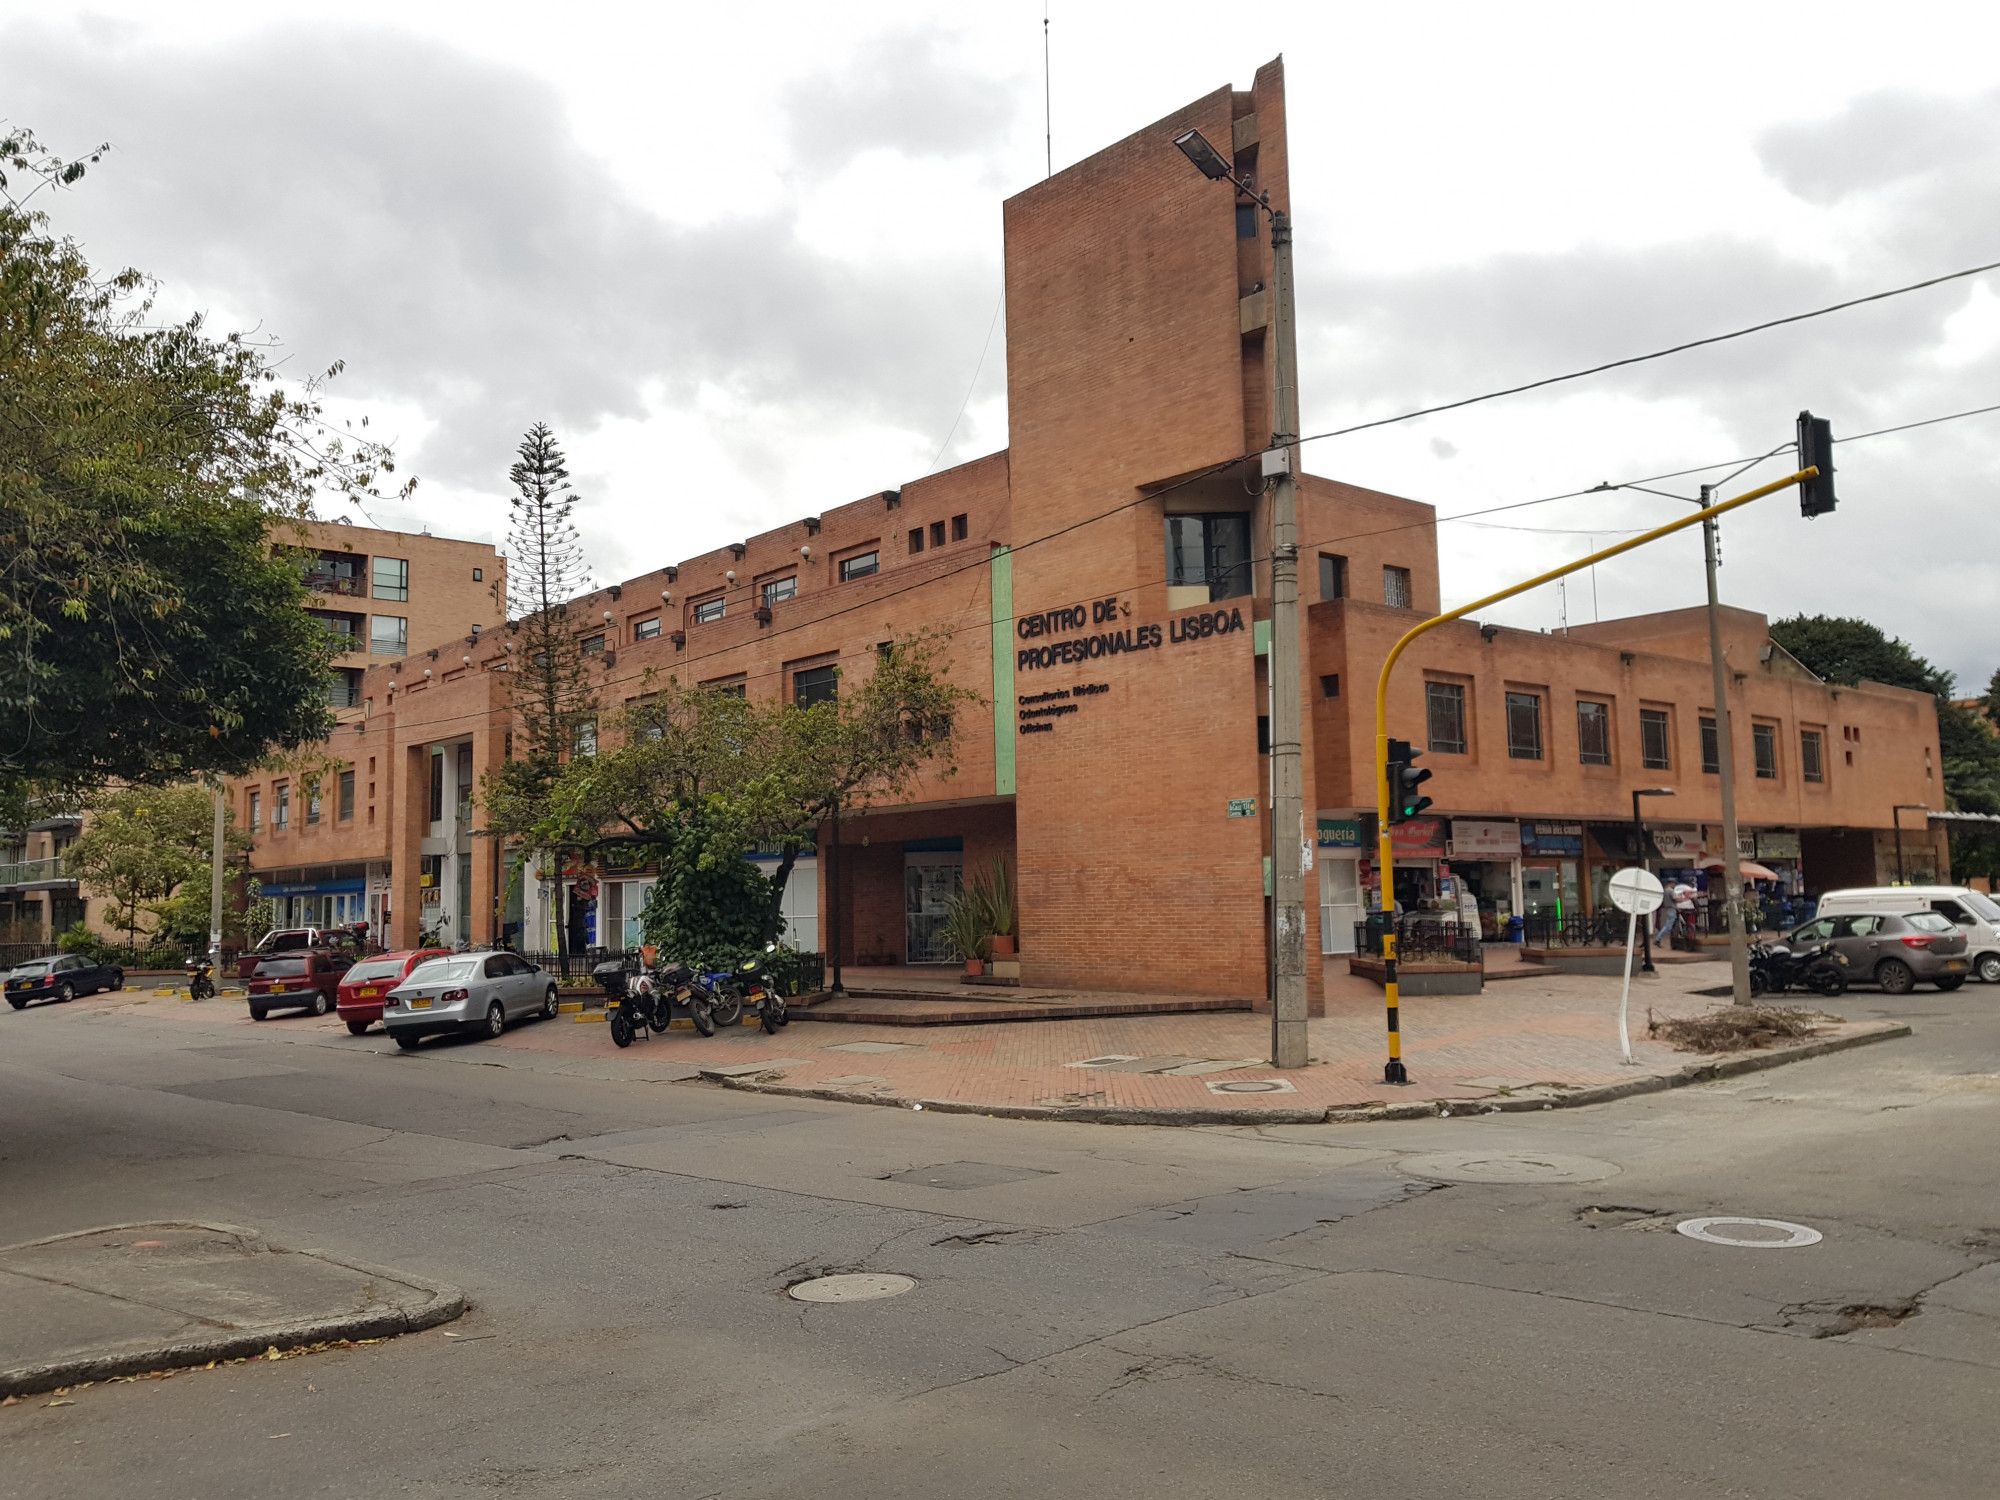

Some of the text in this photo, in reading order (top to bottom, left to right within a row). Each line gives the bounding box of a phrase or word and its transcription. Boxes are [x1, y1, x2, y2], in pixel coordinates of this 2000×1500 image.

[1017, 598, 1117, 639] CENTRO DE
[1018, 608, 1244, 671] PROFESIONALES LISBOA
[1018, 684, 1109, 705] Consultorios Médicos
[1019, 704, 1078, 720] Odontológicos
[1020, 723, 1052, 734] Oficinas
